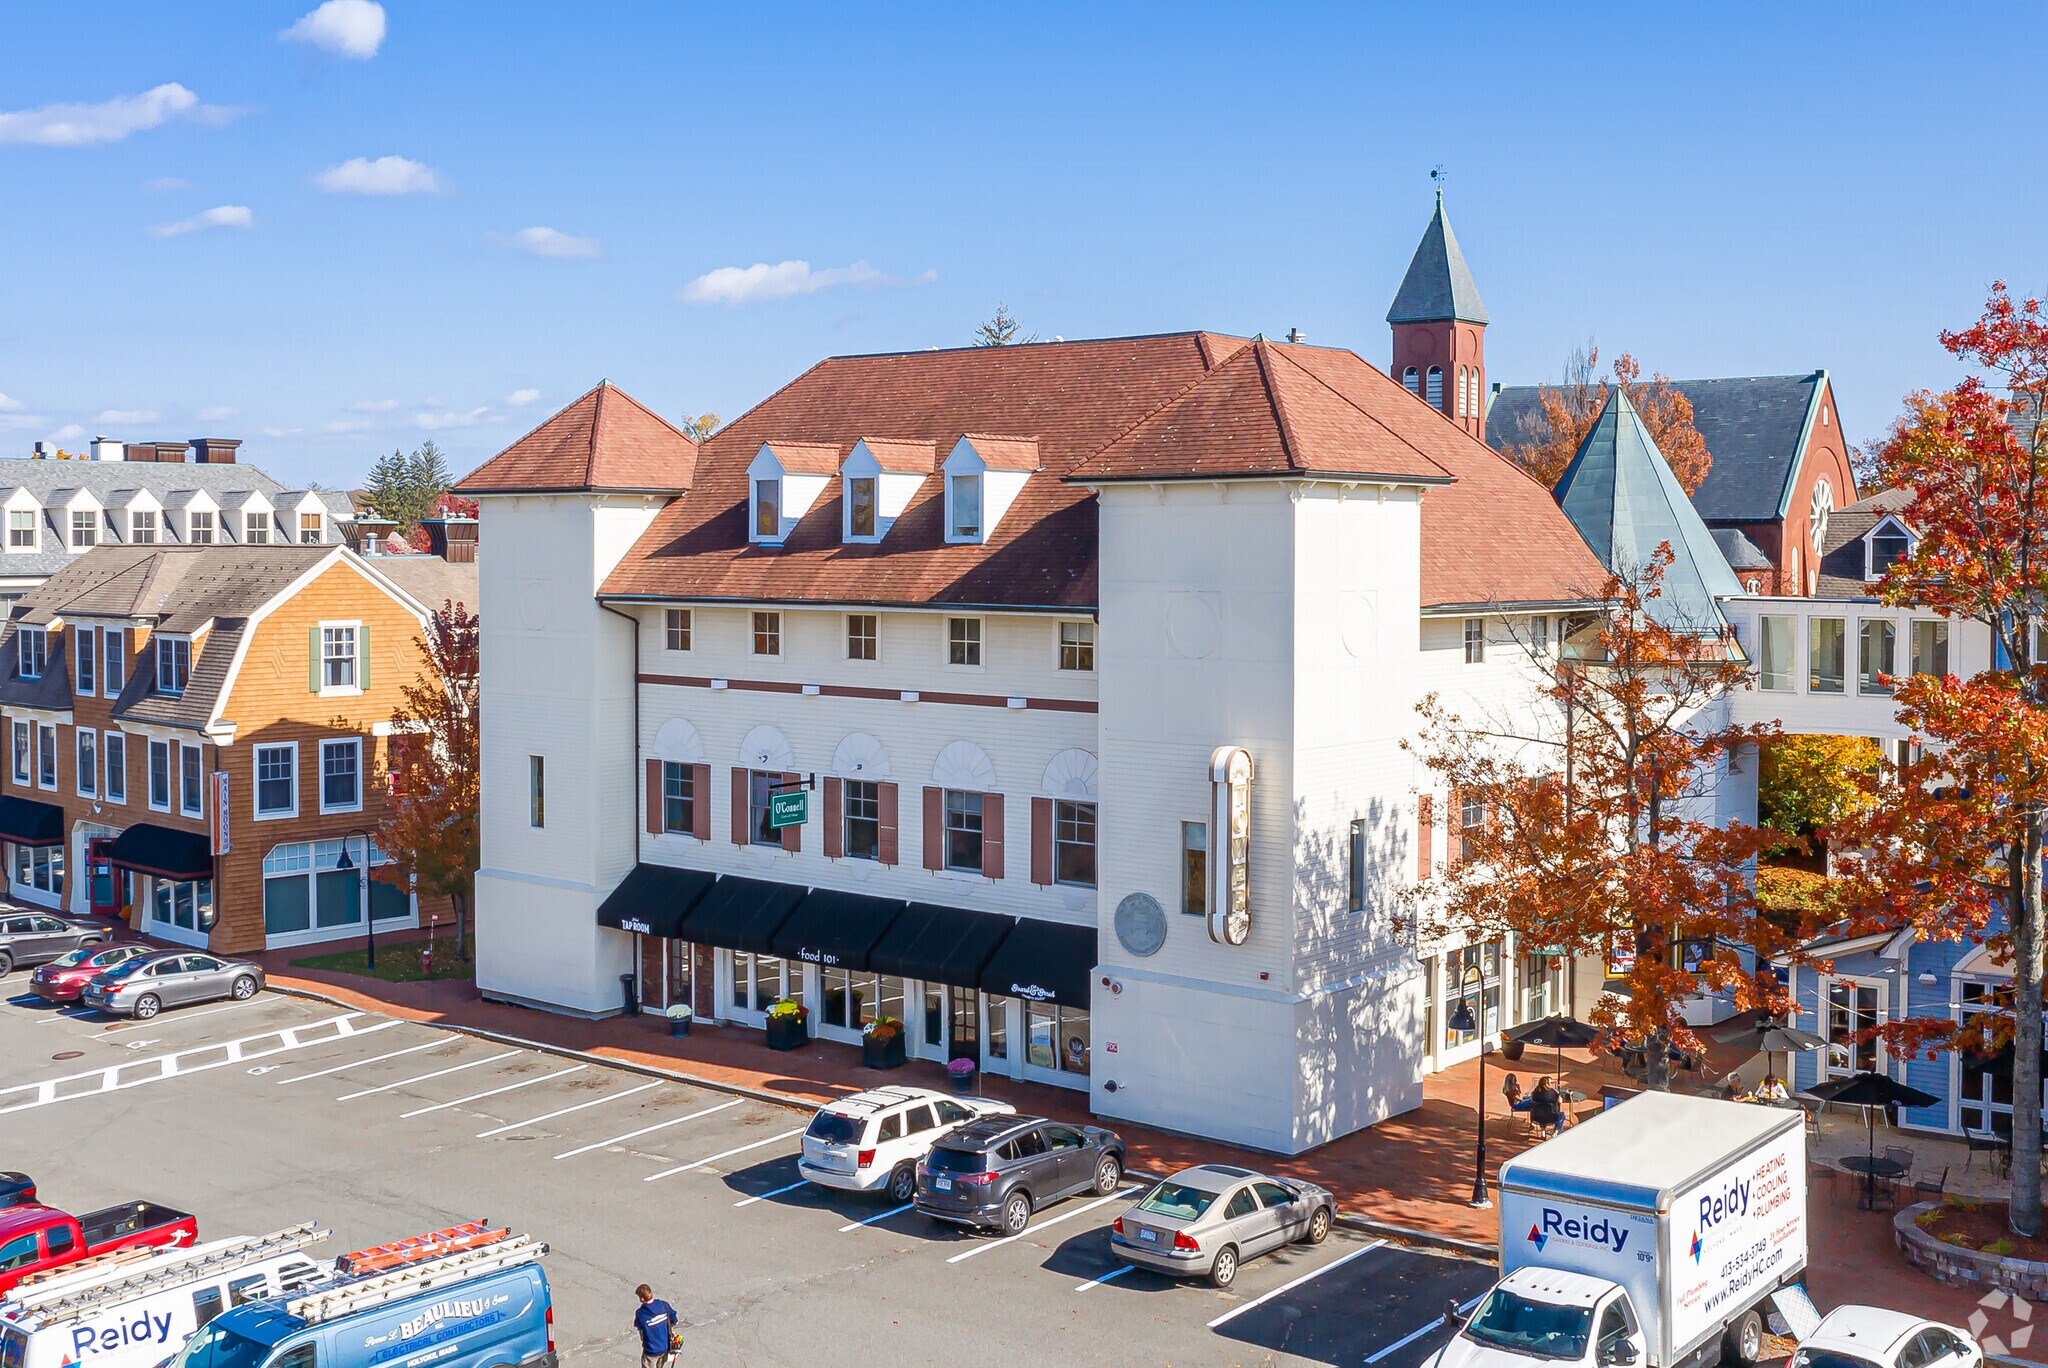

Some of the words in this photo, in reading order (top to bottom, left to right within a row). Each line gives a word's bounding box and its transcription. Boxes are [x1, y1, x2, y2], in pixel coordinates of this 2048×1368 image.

[775, 799, 804, 814] O'Connell
[621, 919, 633, 930] TAP
[633, 922, 650, 934] ROOM
[1755, 1152, 1786, 1181] HEATING
[1756, 1170, 1788, 1200] COOLING
[1756, 1187, 1791, 1219] PLUMBING
[1699, 1176, 1750, 1234] Reidy
[1542, 1207, 1629, 1253] Reidy
[1720, 1238, 1767, 1278] 413-534-3749
[1703, 1248, 1783, 1313] www.ReidyHC.com
[71, 1310, 172, 1359] Reidy
[399, 1297, 484, 1341] BEAULIEU
[436, 1313, 496, 1341] CONTRACTORS
